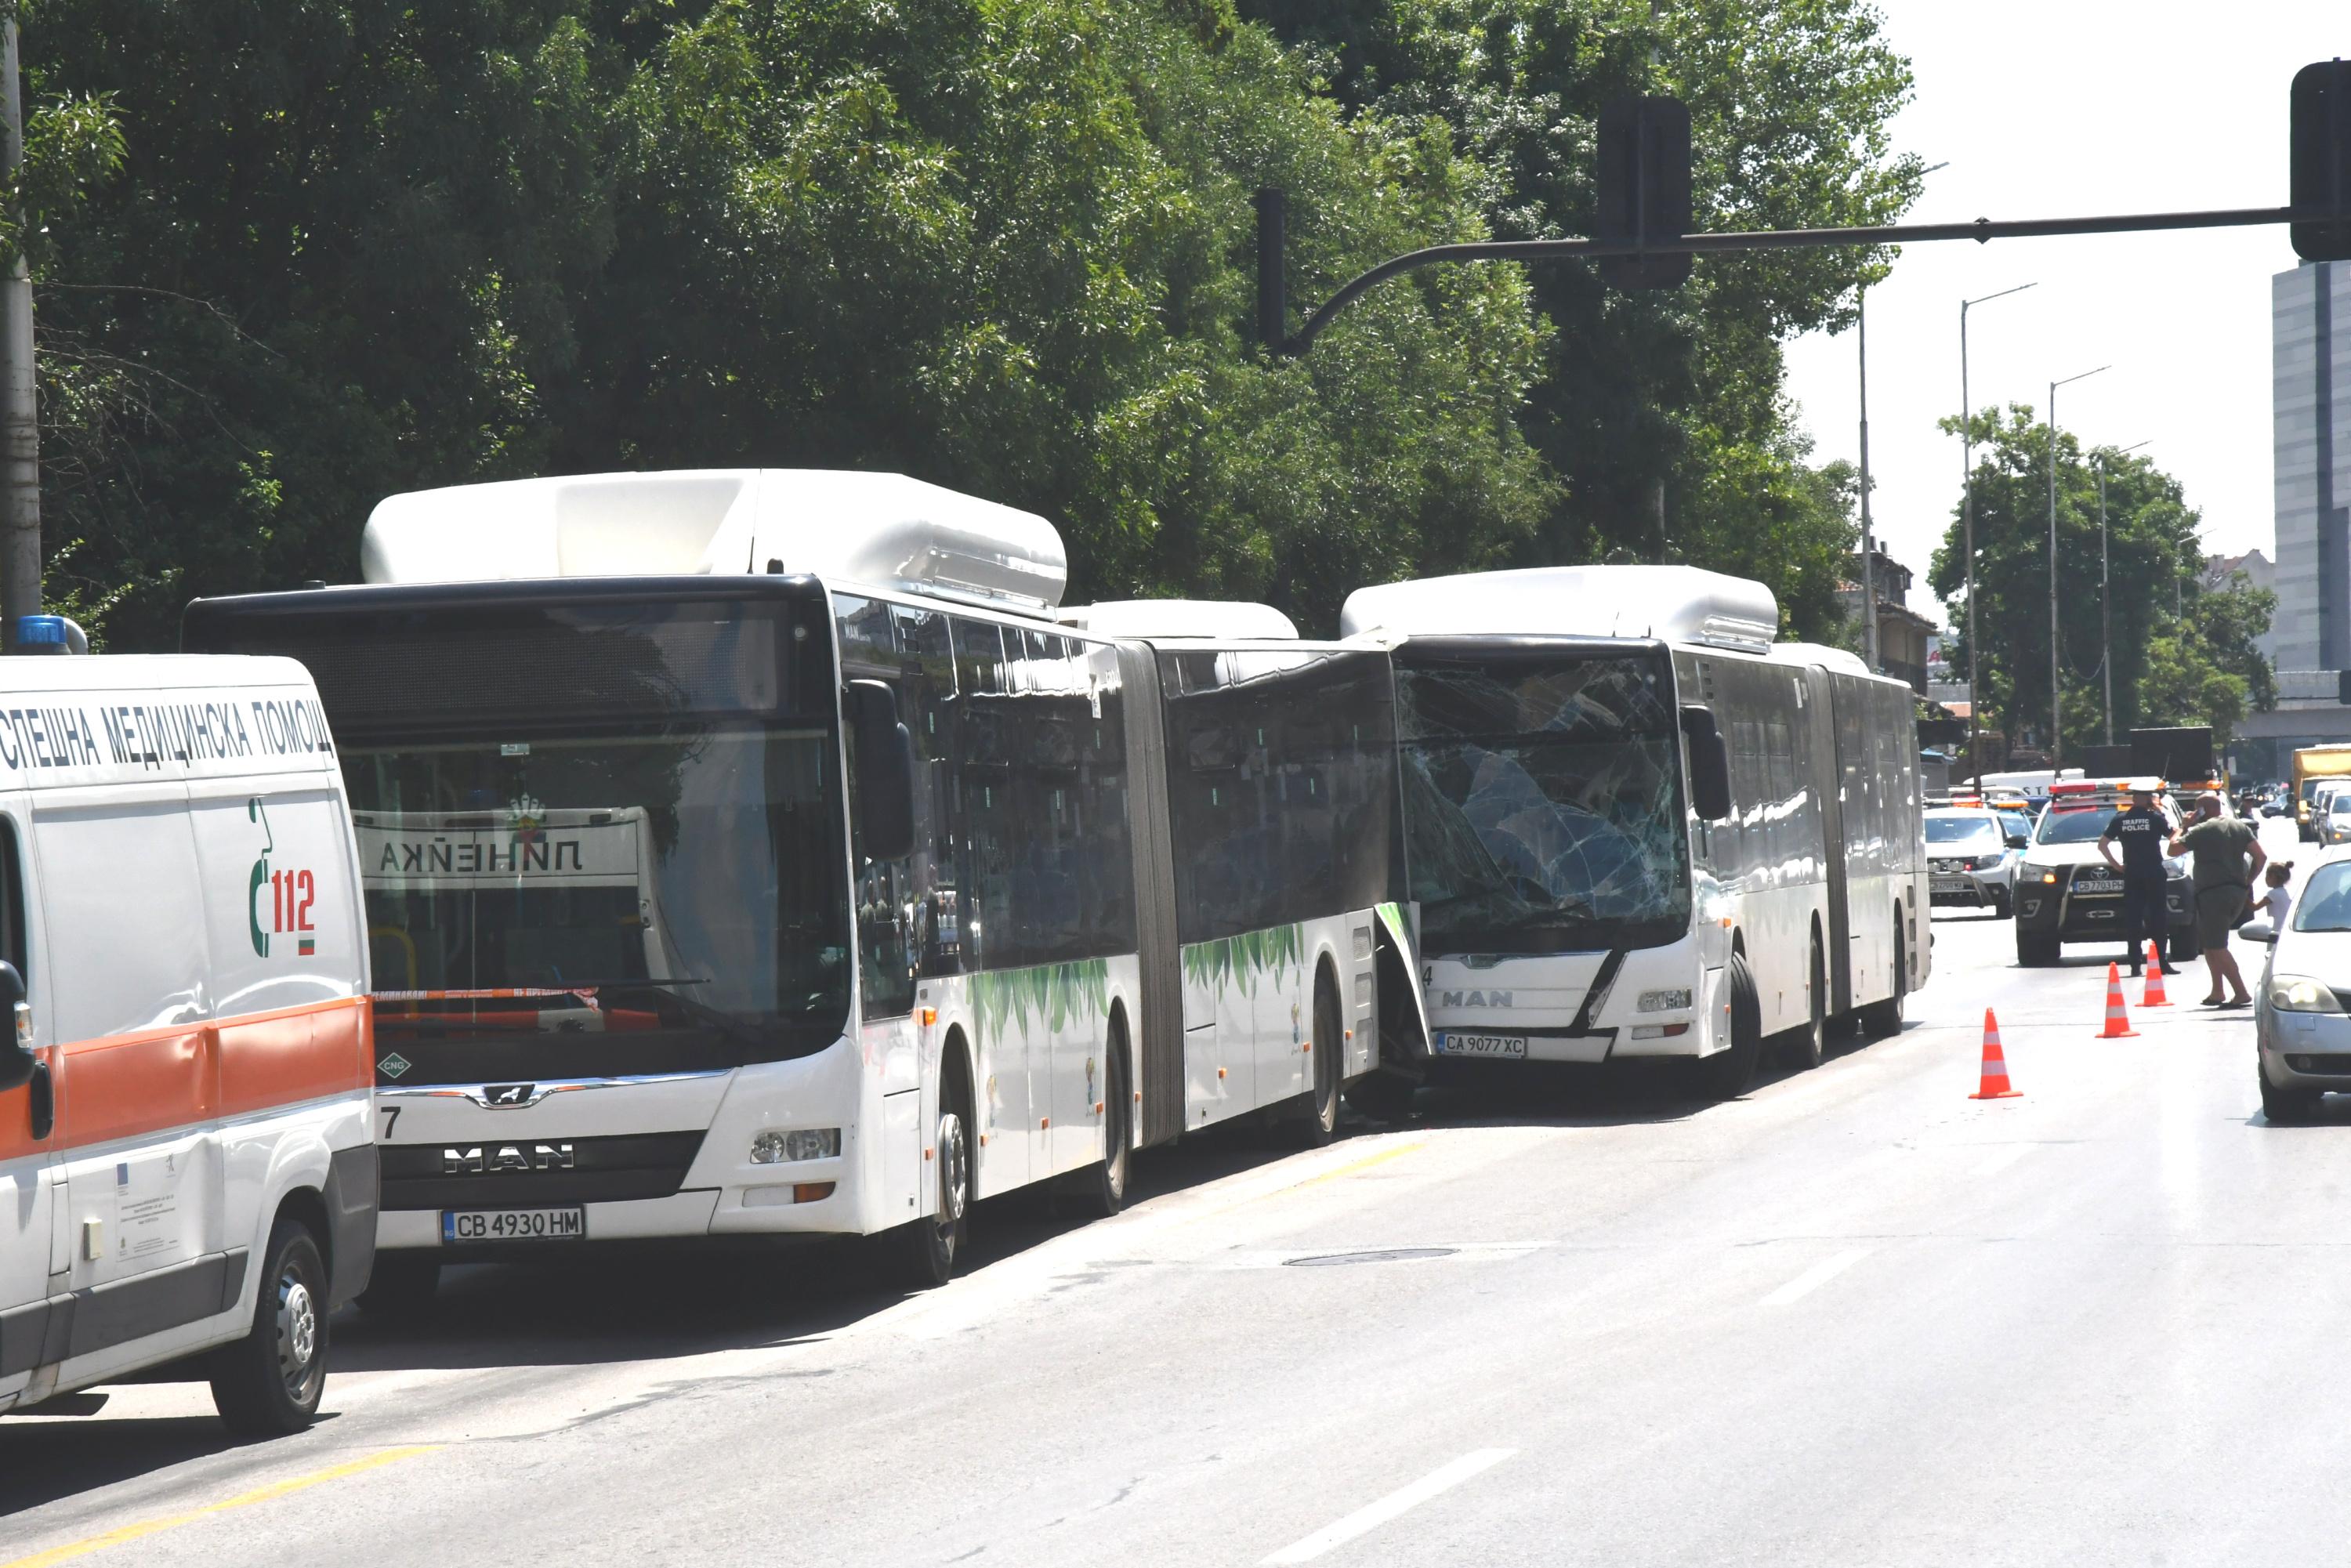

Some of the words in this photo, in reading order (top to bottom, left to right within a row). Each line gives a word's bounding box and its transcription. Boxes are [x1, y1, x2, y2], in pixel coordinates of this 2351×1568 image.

[0, 708, 101, 770] СПЕШНА
[100, 702, 253, 771] МЕДИЦИНСКА
[252, 699, 335, 759] ПОМОЩ
[2091, 882, 2111, 890] 7703
[271, 869, 315, 932] 112
[1422, 965, 1433, 986] 4
[1442, 990, 1513, 1008] MAN
[1467, 1037, 1502, 1052] 9077
[1504, 1039, 1523, 1053] XC
[383, 1061, 405, 1070] CNG
[381, 1106, 401, 1139] 7
[444, 1143, 574, 1174] MAN
[491, 1213, 545, 1236] 4930
[549, 1211, 579, 1234] HM
